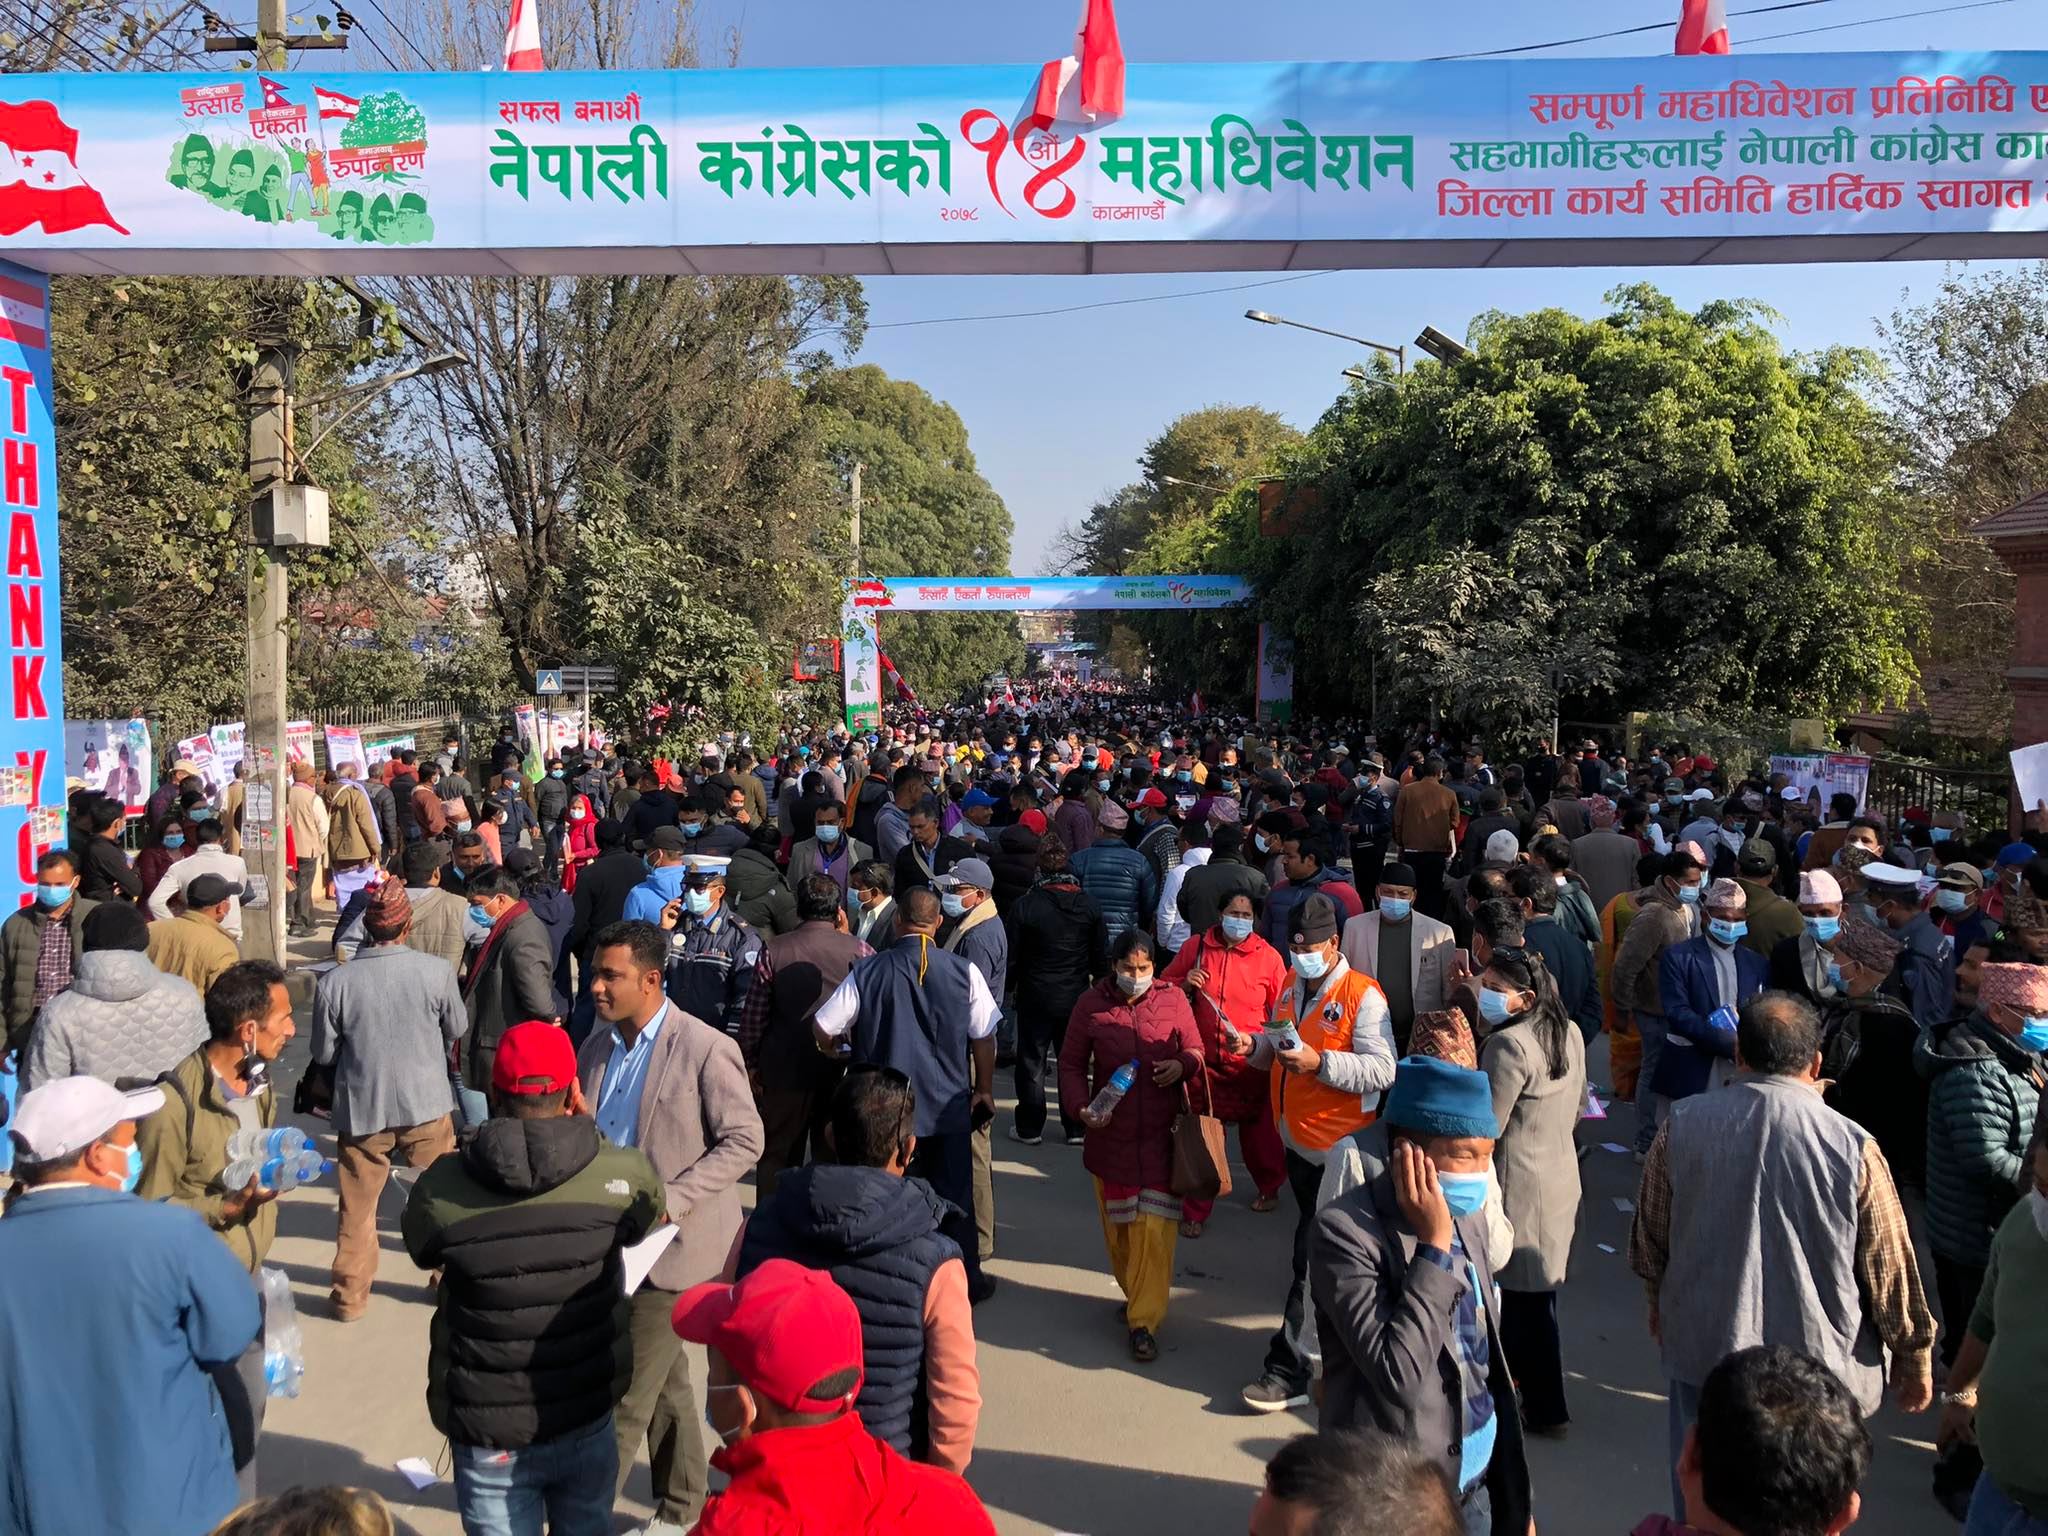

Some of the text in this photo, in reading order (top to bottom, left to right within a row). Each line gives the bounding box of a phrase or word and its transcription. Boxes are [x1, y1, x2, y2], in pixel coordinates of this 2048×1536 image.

[182, 95, 244, 117] उत्साह
[500, 92, 641, 124] सफल बनाऔं
[1529, 85, 1646, 129] सम्पूर्ण
[1658, 80, 1857, 119] महाधिवेशन
[1870, 75, 2016, 118] प्रतिनिधि
[249, 116, 307, 139] एकता
[1739, 127, 1858, 165] नेपाली
[1870, 124, 1984, 165] कांग्रेस
[1996, 132, 2048, 159] का
[330, 152, 425, 178] रुपान्तरण
[489, 124, 667, 204] नेपाली
[697, 123, 950, 200] कांग्रेसको
[960, 109, 1086, 219] १४
[1098, 113, 1414, 205] महाधिवेशन
[1437, 178, 1555, 217] जिल्ला
[1567, 179, 1648, 215] कार्य
[1660, 175, 1775, 216] समिति
[1786, 172, 1904, 215] हार्दिक
[1916, 179, 2033, 211] स्वागत
[940, 208, 979, 221] २०७८
[2, 366, 49, 720] THANK
